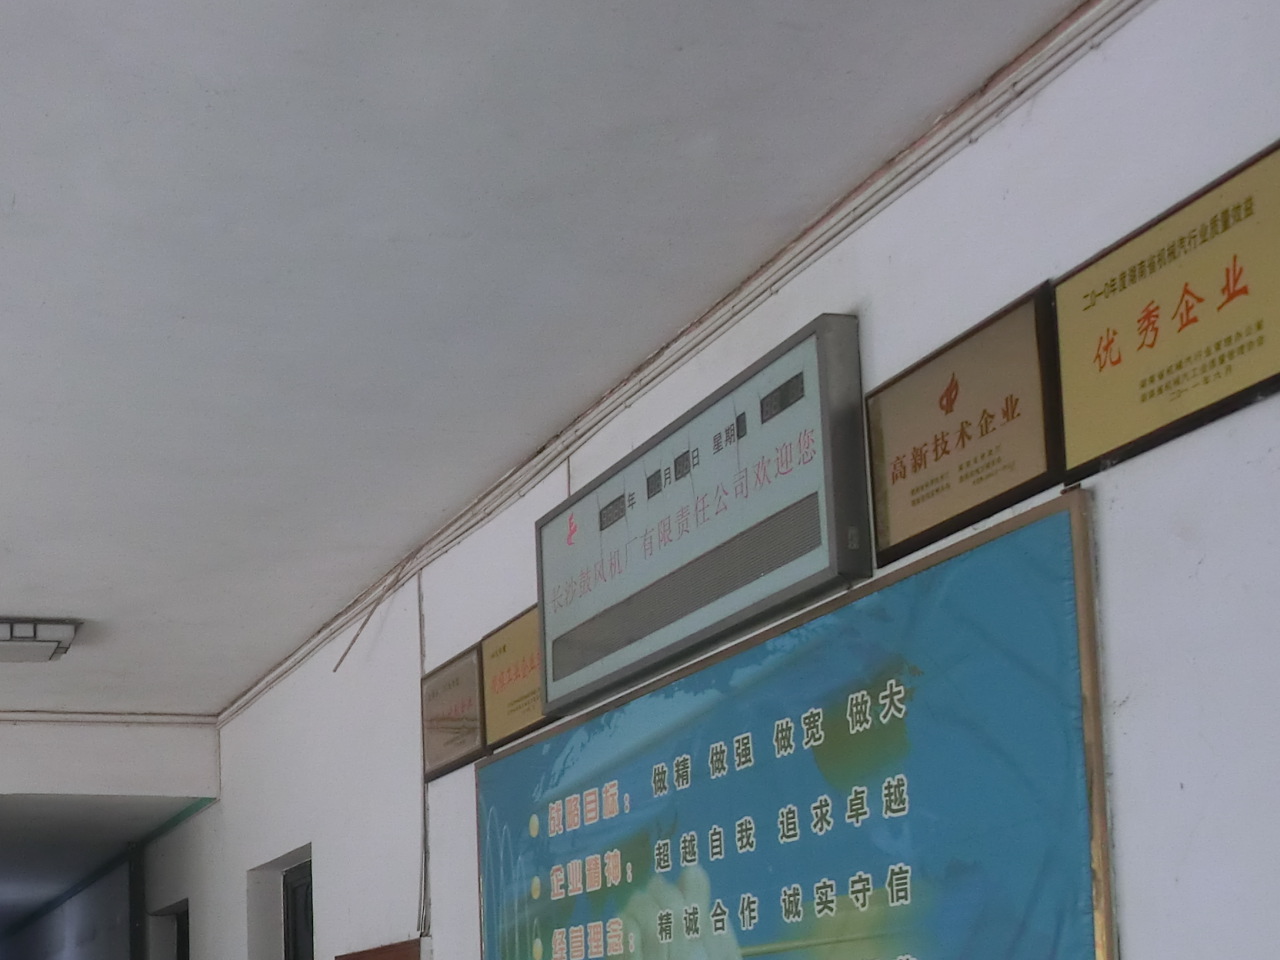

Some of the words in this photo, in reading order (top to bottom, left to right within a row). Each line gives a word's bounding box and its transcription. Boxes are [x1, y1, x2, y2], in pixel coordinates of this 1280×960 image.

[1093, 253, 1249, 373] 优秀企业
[627, 492, 636, 510] 年
[663, 466, 672, 488] 月
[691, 448, 700, 469] 日
[712, 423, 736, 454] 星期
[890, 393, 1021, 485] 高新技术企业
[652, 754, 691, 797] 做精
[709, 732, 754, 779] 做强
[774, 708, 824, 758] 做宽
[847, 679, 906, 734] 做大
[654, 816, 755, 872] 超越自我
[778, 774, 907, 843] 追求卓越
[657, 893, 759, 942] 精诚合作
[781, 863, 911, 923] 诚实守信
